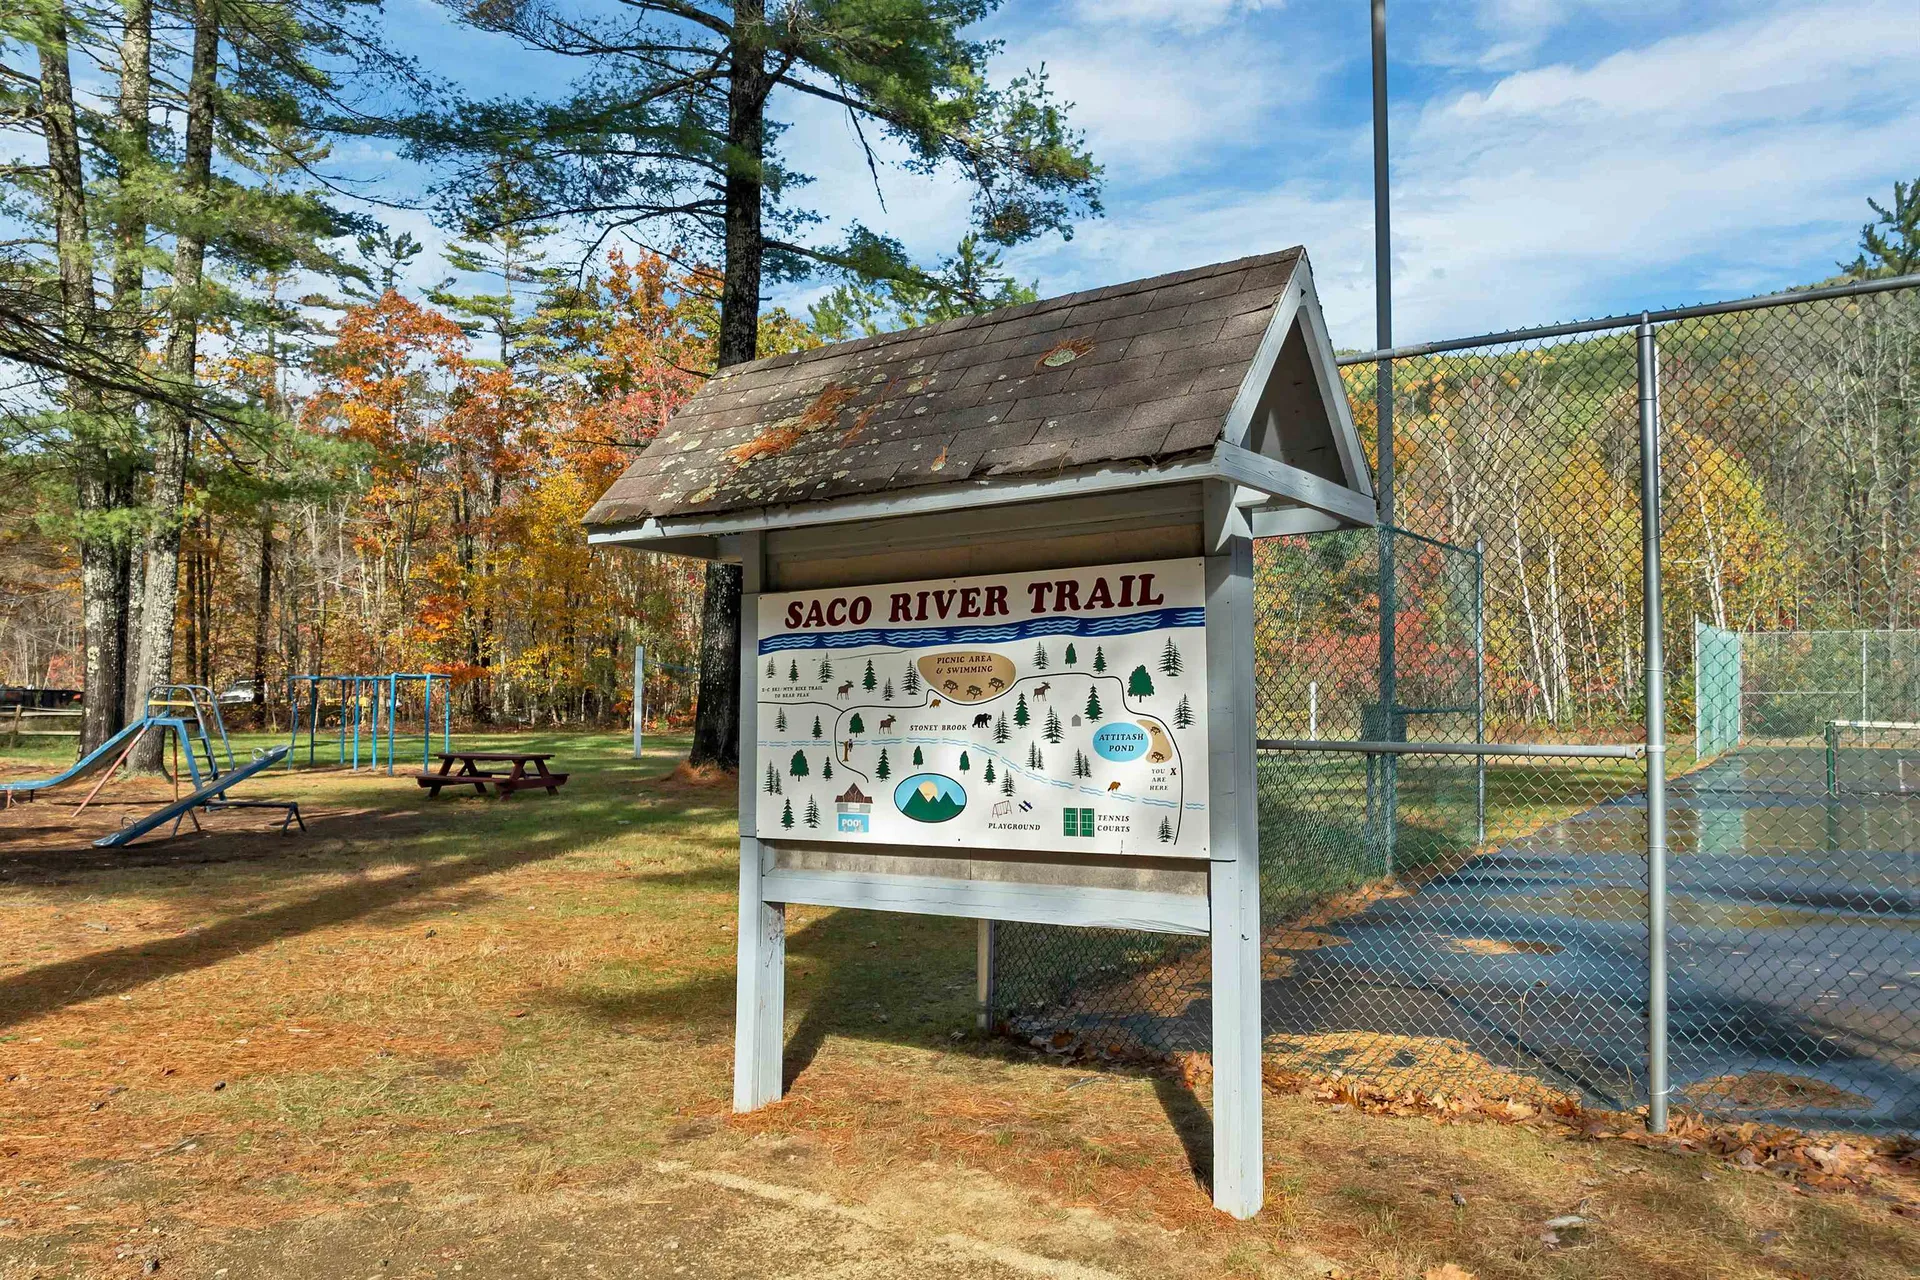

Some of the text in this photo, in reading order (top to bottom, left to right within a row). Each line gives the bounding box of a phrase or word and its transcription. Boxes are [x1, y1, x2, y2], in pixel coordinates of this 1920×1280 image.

[785, 574, 1165, 629] SACO RIVER TRAIL
[936, 655, 992, 664] PICNIC AREA
[936, 665, 993, 675] & SWIMMING
[1098, 733, 1144, 741] ATTITASH
[1108, 744, 1135, 752] POND
[1169, 767, 1177, 776] X
[1097, 814, 1130, 822] TENNIS
[988, 822, 1041, 831] PLAYGROUND
[1097, 824, 1131, 833] COURTS
